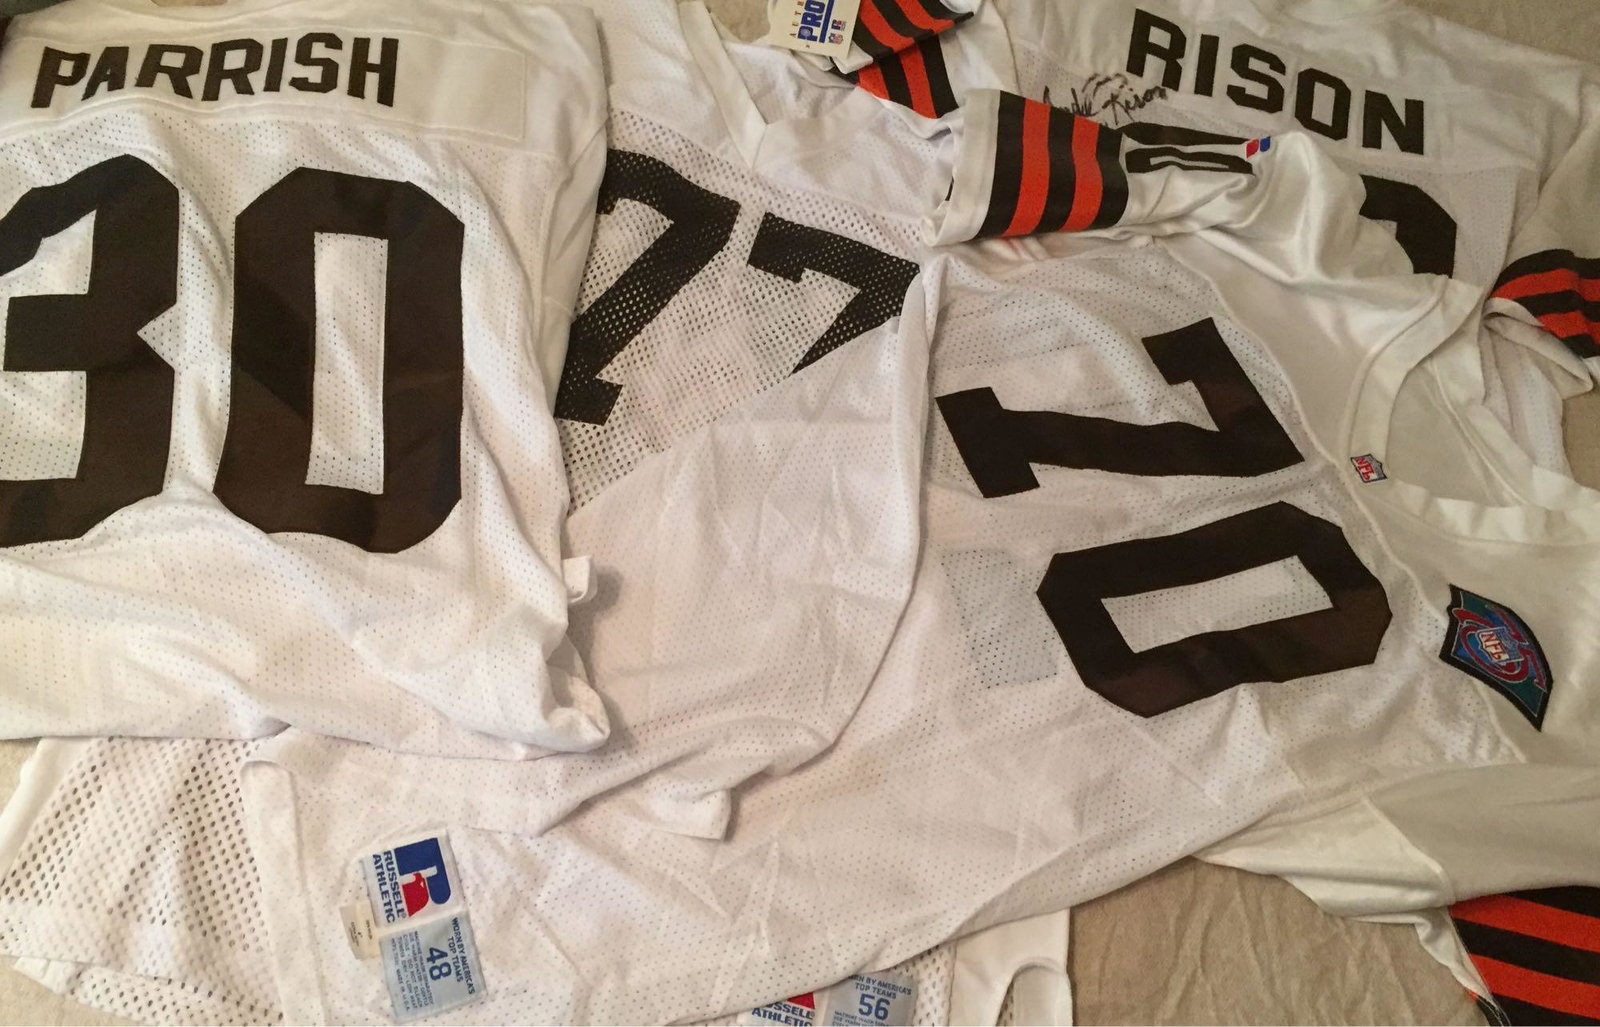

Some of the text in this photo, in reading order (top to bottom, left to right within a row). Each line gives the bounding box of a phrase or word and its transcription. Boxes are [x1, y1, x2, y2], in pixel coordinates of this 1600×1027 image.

[30, 32, 400, 108] PARRISH
[1126, 8, 1424, 156] RISON
[0, 154, 465, 552] 30
[371, 852, 396, 923] ATHLETIC
[383, 850, 404, 918] RUSSELL
[427, 946, 452, 982] 48
[446, 935, 464, 983] TOP TEAMS
[450, 917, 475, 995] WORN BY AMERICA'S
[865, 977, 877, 985] BY
[877, 979, 912, 996] AMERICA'S
[855, 982, 897, 999] TOP TEAMS
[858, 993, 891, 1021] 56
